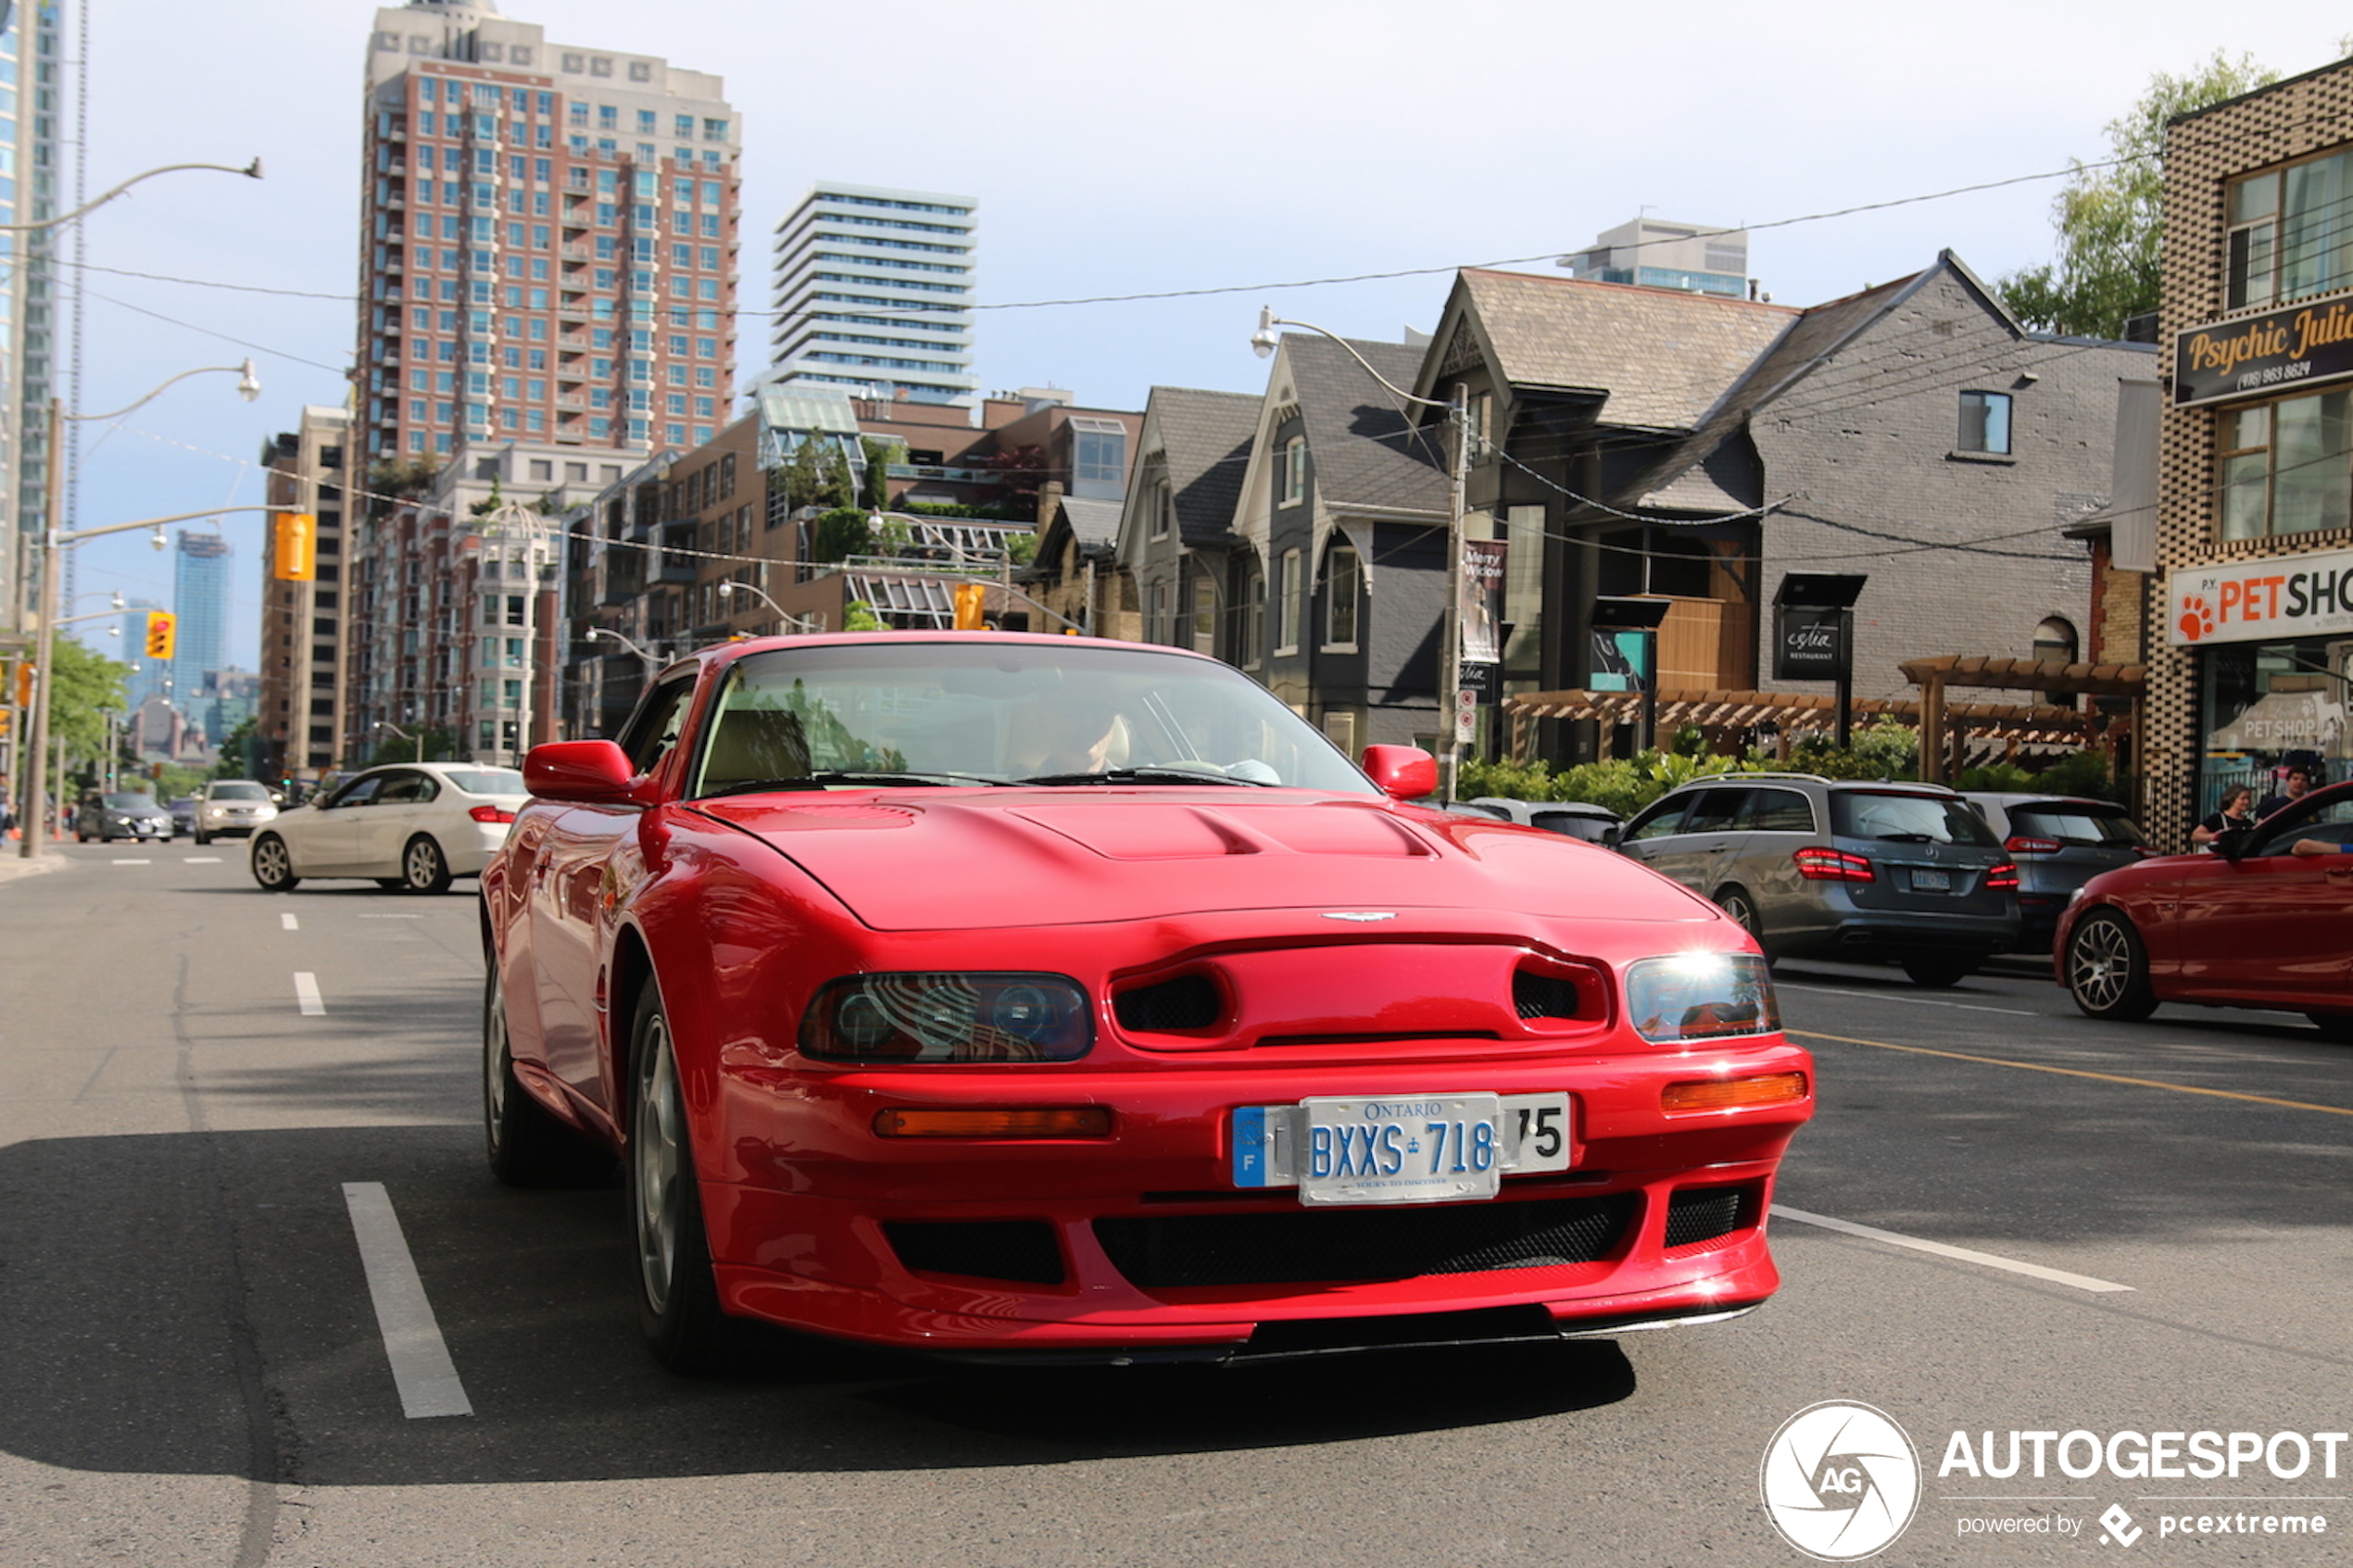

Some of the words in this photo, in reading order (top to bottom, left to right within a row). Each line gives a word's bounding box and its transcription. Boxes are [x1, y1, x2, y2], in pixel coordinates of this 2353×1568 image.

[2189, 320, 2288, 376] Psychic
[1466, 551, 1501, 567] Merry
[1465, 564, 1504, 578] Widow
[2202, 579, 2218, 591] P.Y.
[1790, 652, 1833, 660] RESTAURANT
[2246, 721, 2272, 738] PET
[2275, 719, 2316, 737] SHOP
[1312, 1122, 1404, 1178] BXXS
[1427, 1119, 1493, 1173] 718
[1243, 1155, 1255, 1171] F
[1404, 1178, 1448, 1186] DISCOVER
